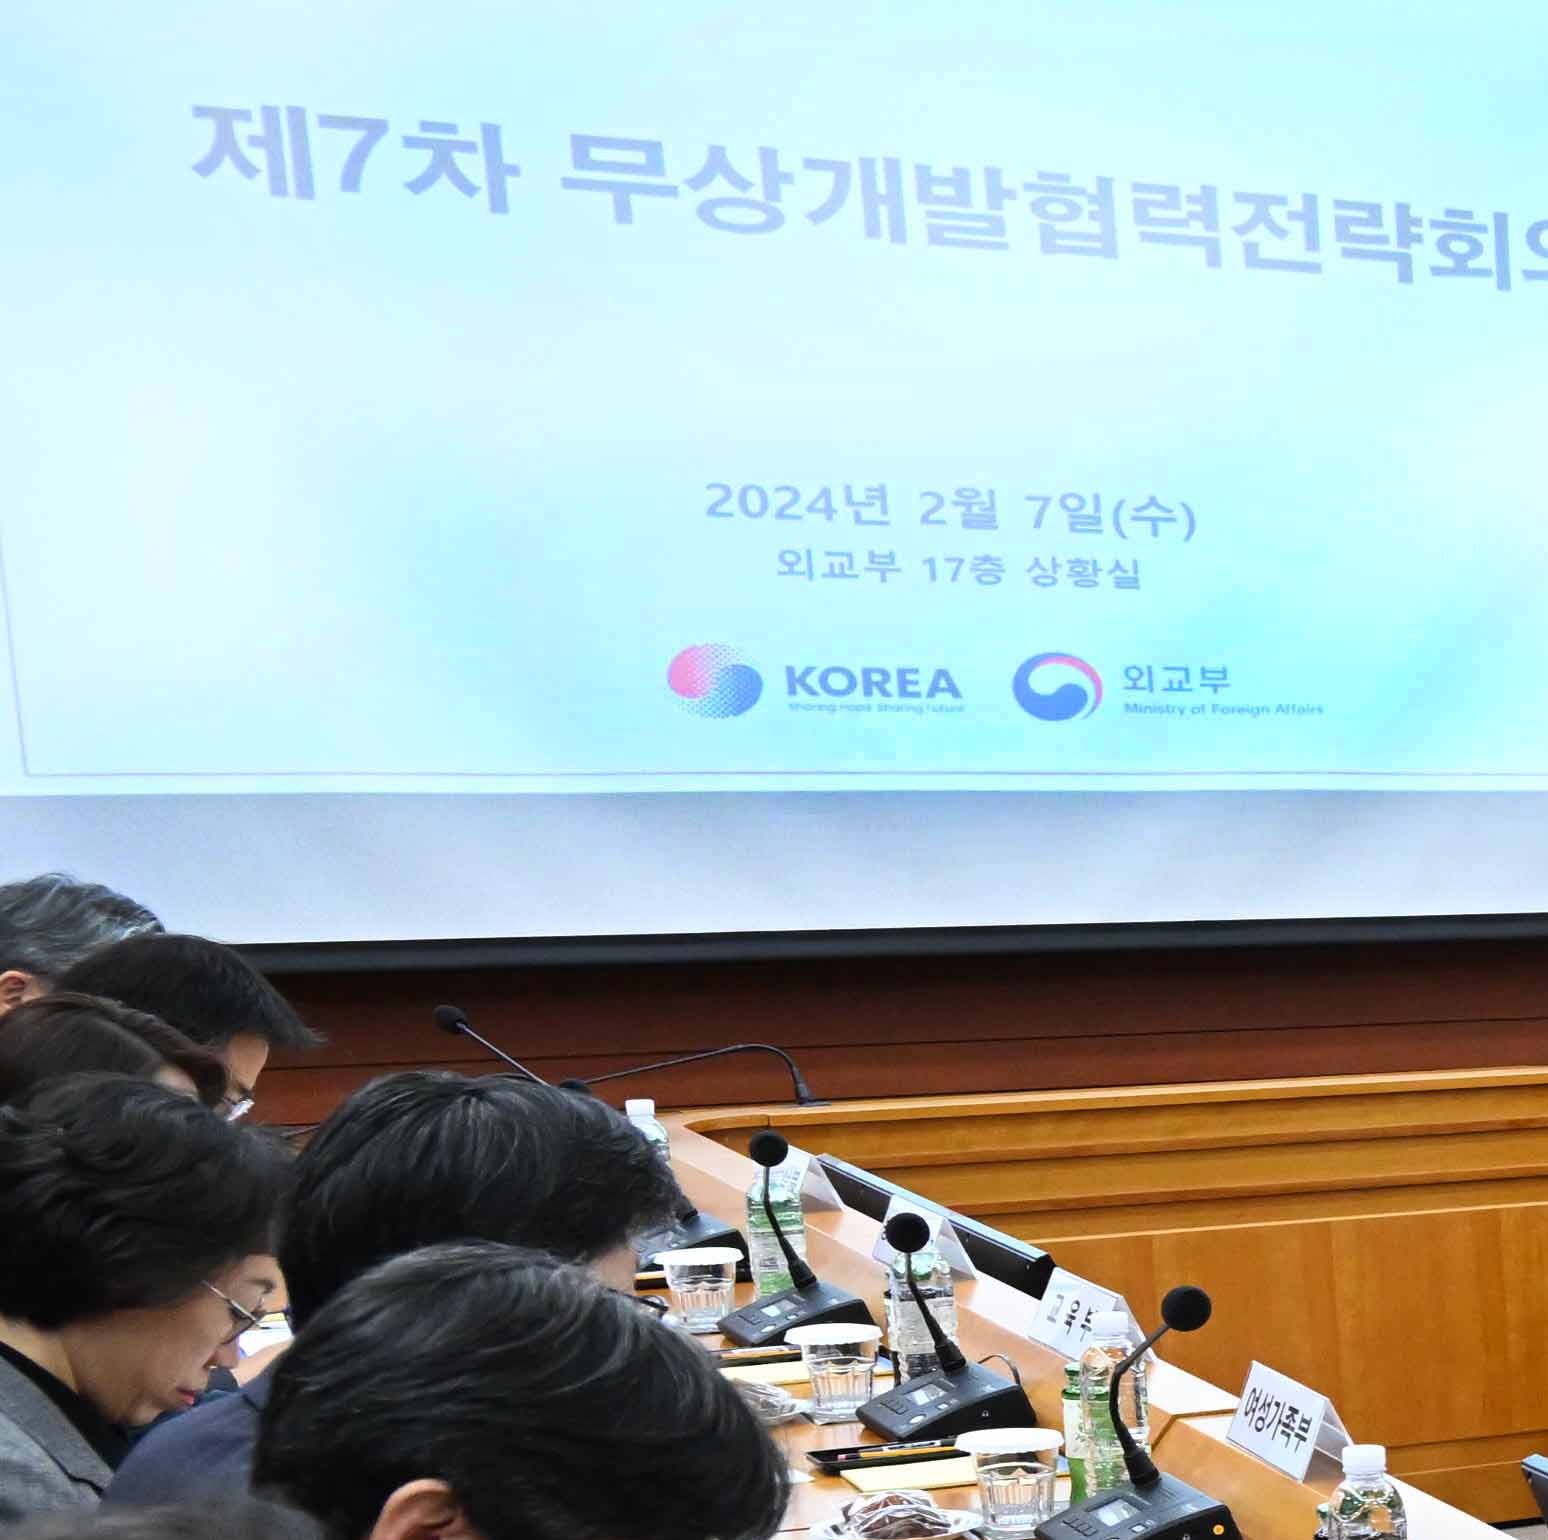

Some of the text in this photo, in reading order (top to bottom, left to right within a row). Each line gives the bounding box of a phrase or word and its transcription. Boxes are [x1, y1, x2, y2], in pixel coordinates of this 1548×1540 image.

[190, 103, 521, 215] 제7차
[703, 482, 1197, 542] 2024년 2월 7일(수)
[776, 548, 1141, 591] 외교부 17층 상황실
[785, 665, 963, 699] KOREA
[1122, 664, 1230, 695] 외교부
[1244, 1387, 1313, 1454] 여성가족부
